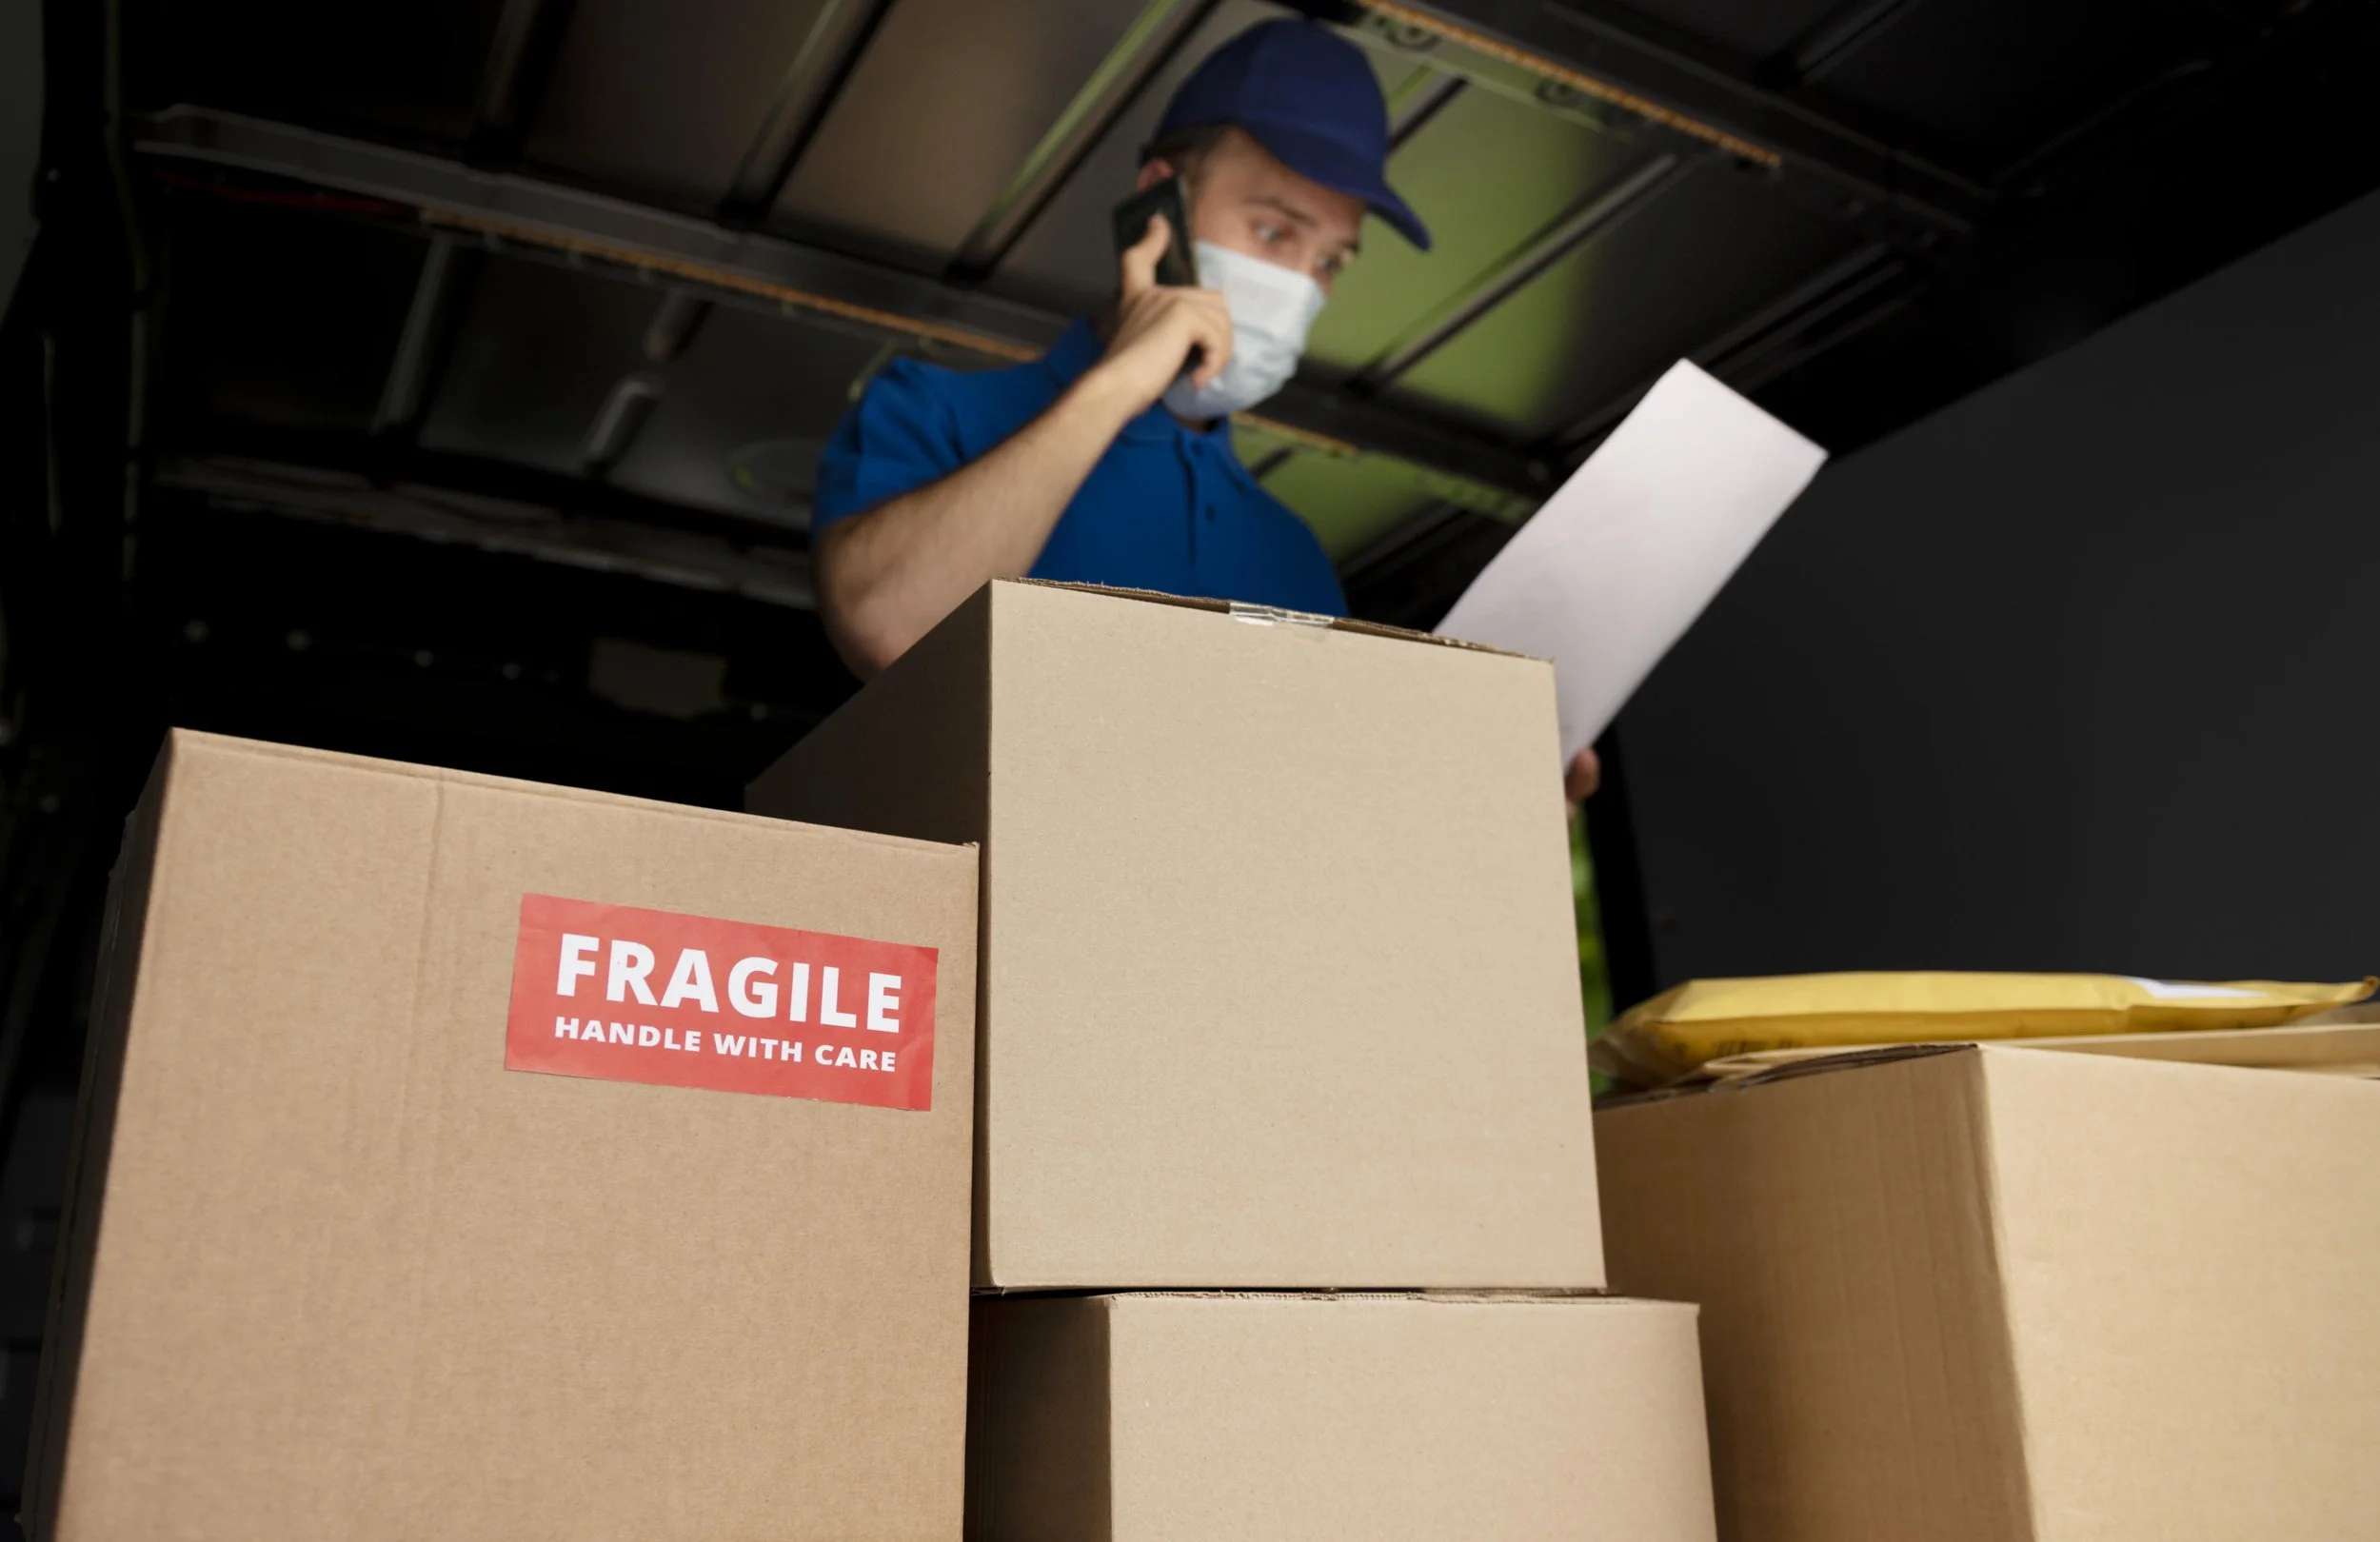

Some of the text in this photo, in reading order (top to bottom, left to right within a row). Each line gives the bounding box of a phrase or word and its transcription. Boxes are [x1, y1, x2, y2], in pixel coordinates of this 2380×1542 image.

[556, 933, 902, 1034] FRAGILE
[554, 1016, 897, 1073] HANDLE WITH CARE
